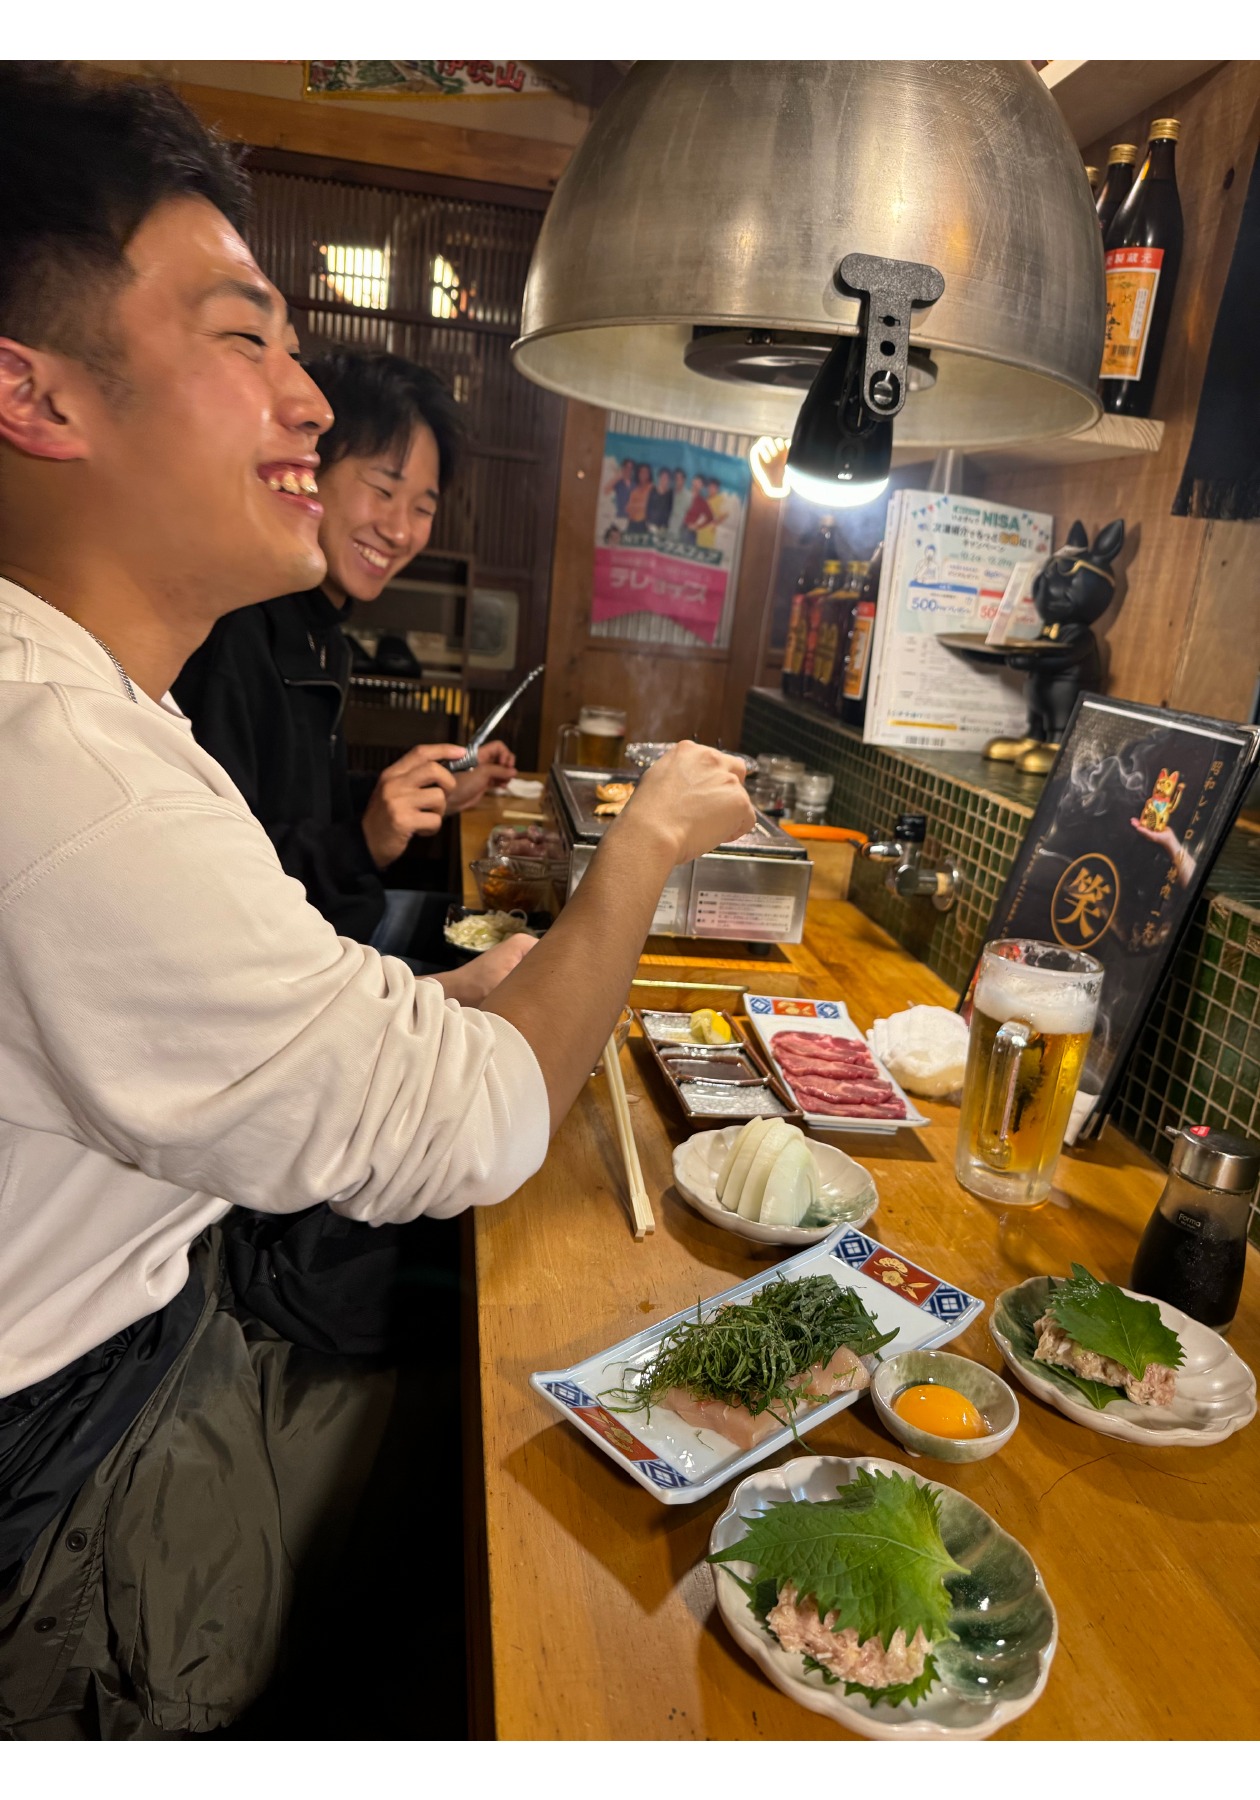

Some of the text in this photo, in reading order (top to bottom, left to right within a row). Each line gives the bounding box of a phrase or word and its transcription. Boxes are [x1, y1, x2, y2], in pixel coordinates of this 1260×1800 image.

[982, 510, 1021, 531] NISA
[1184, 760, 1224, 840] 昭和レトロ
[1055, 866, 1111, 939] 笑
